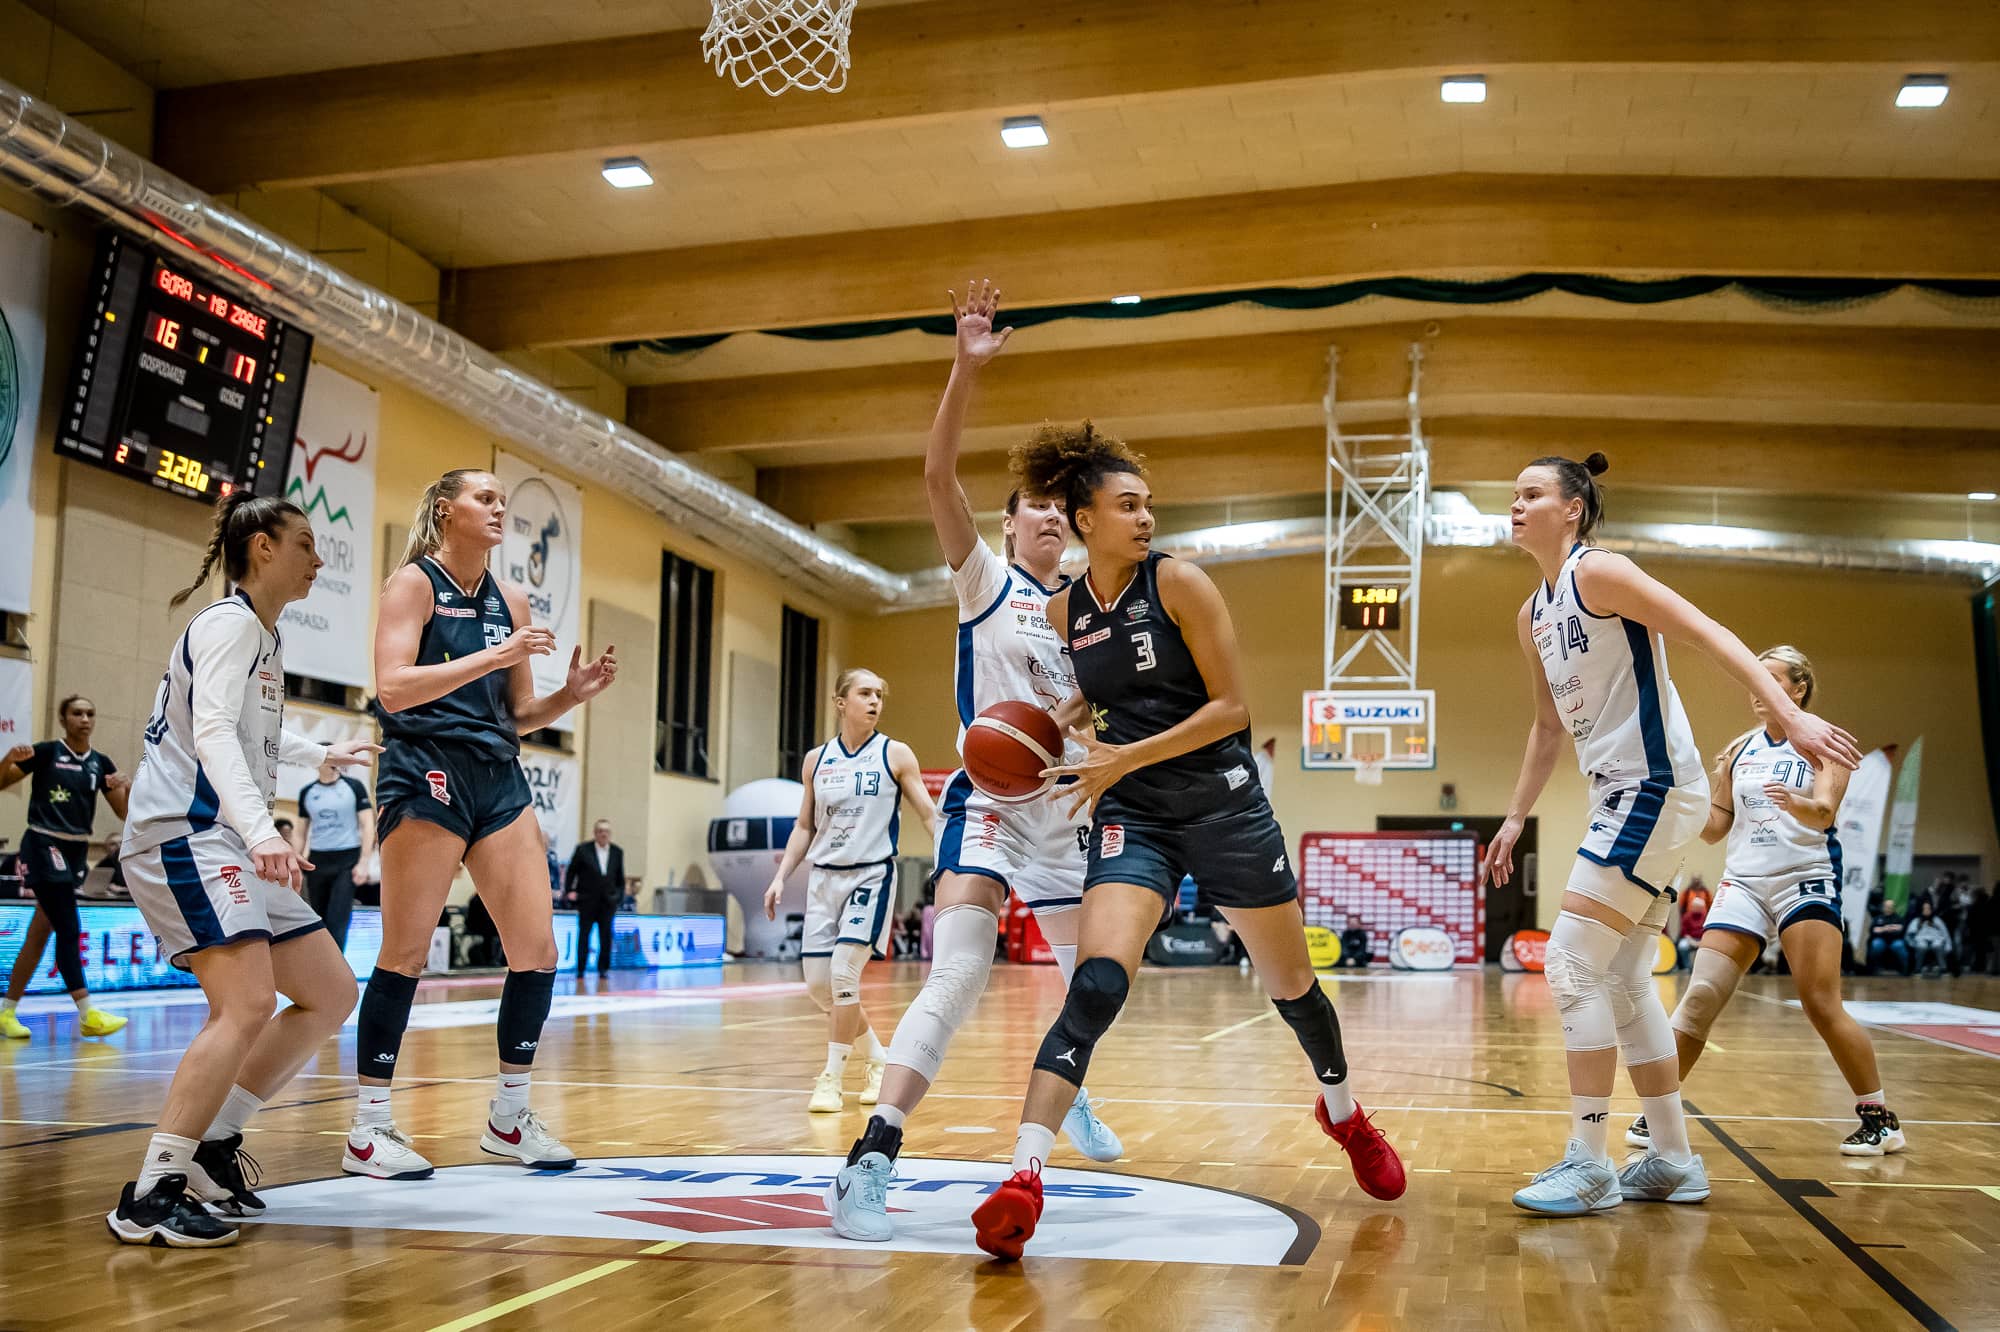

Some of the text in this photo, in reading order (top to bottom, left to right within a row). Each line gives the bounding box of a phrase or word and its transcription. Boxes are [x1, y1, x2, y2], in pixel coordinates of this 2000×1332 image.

[155, 318, 180, 350] 16
[198, 346, 208, 364] 1
[234, 354, 257, 385] 17
[115, 443, 129, 464] 2
[438, 591, 454, 604] 4F
[1074, 612, 1093, 632] 4F
[1363, 606, 1385, 627] 11
[1557, 614, 1590, 661] 14
[1131, 631, 1157, 672] 3
[1344, 706, 1419, 718] SUZUKI
[854, 771, 880, 796] 13
[1770, 760, 1807, 788] 91
[1272, 854, 1286, 873] 4F
[1581, 1112, 1609, 1123] 4F
